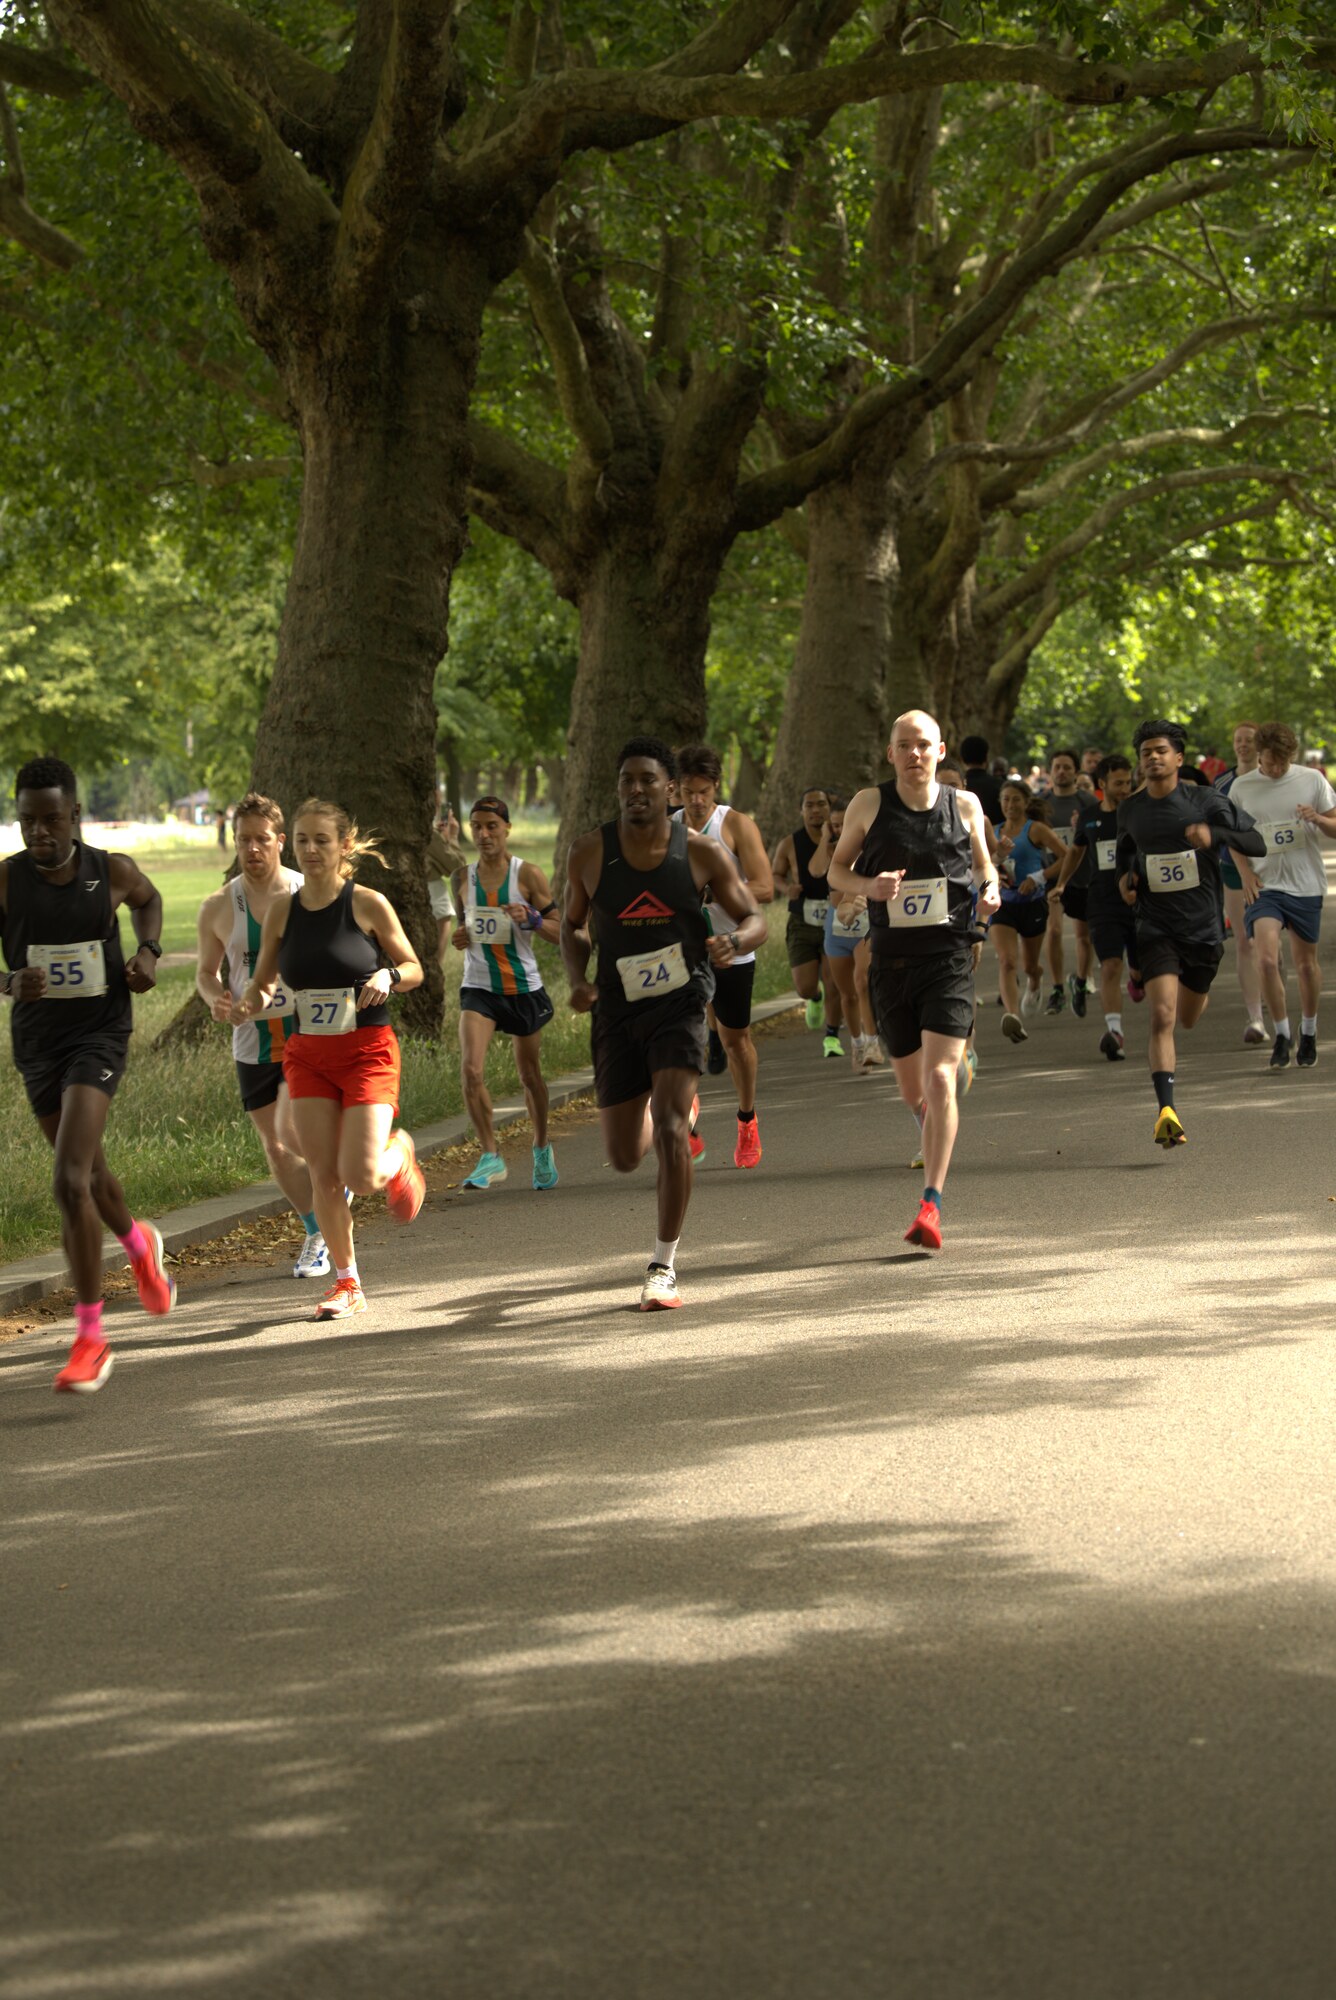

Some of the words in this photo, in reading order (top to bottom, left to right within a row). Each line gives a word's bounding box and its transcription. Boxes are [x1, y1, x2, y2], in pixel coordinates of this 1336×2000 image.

[1275, 829, 1294, 845] 63
[1107, 849, 1116, 863] 5
[1160, 865, 1184, 883] 36
[812, 908, 828, 920] 42
[903, 894, 932, 916] 67
[475, 918, 497, 935] 30
[50, 960, 84, 986] 55
[638, 962, 671, 988] 24
[311, 1002, 338, 1025] 27
